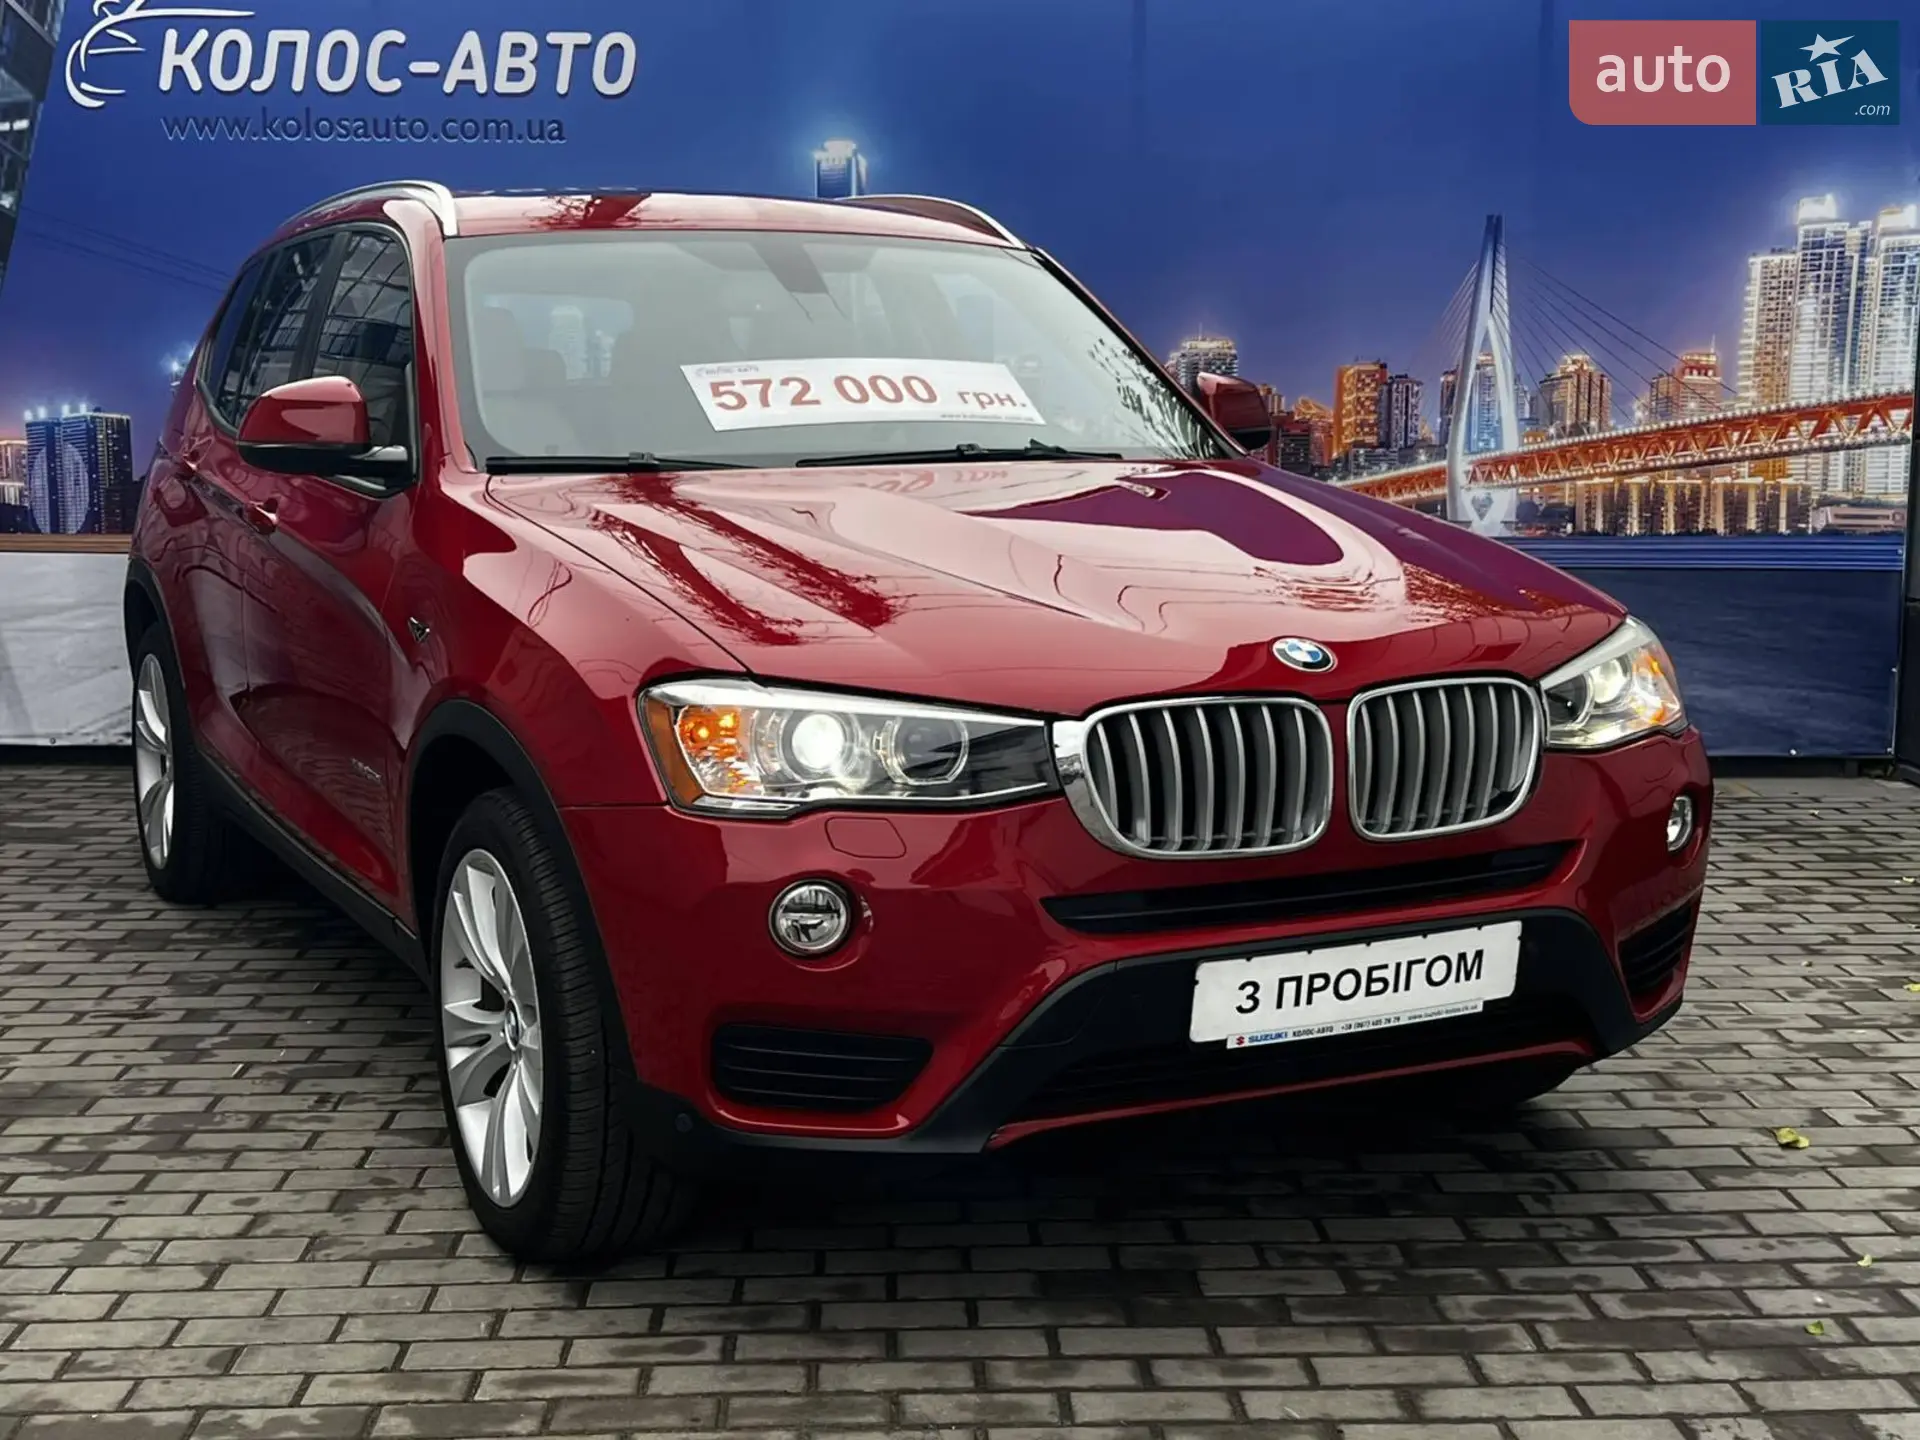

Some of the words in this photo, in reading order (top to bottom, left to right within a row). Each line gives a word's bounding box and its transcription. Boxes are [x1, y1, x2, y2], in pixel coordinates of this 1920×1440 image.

[158, 28, 637, 96] КОЛОС-АВТО
[160, 106, 567, 143] www.kolosauto.com.ua
[709, 376, 821, 411] 572
[832, 375, 938, 405] 000
[956, 390, 1028, 410] грн.
[1275, 949, 1485, 1010] ПРОБІГОМ
[1248, 1031, 1288, 1043] SUZUKI
